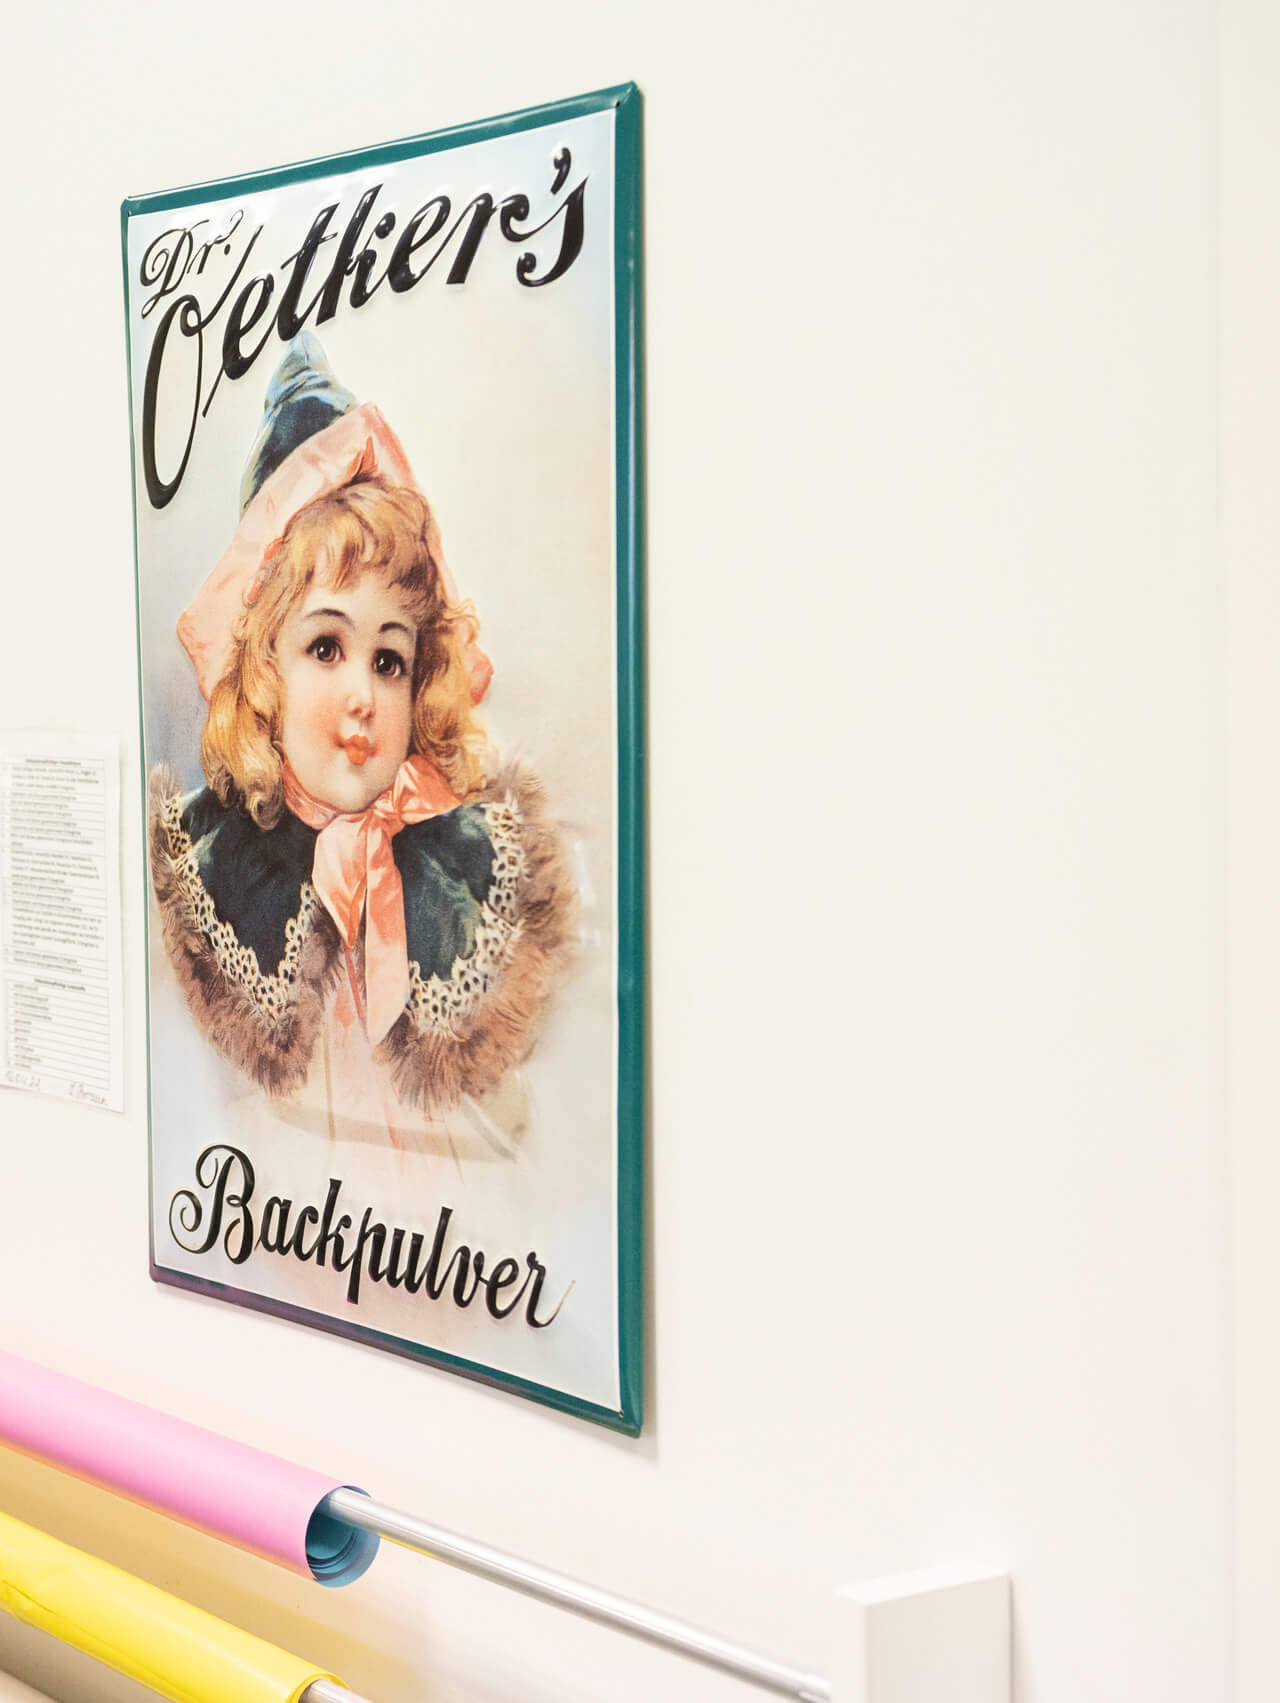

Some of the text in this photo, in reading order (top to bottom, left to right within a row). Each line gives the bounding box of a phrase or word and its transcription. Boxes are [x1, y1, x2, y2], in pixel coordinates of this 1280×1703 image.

[140, 146, 589, 510] Dr. Oetker's
[169, 1144, 576, 1329] Backpulver
